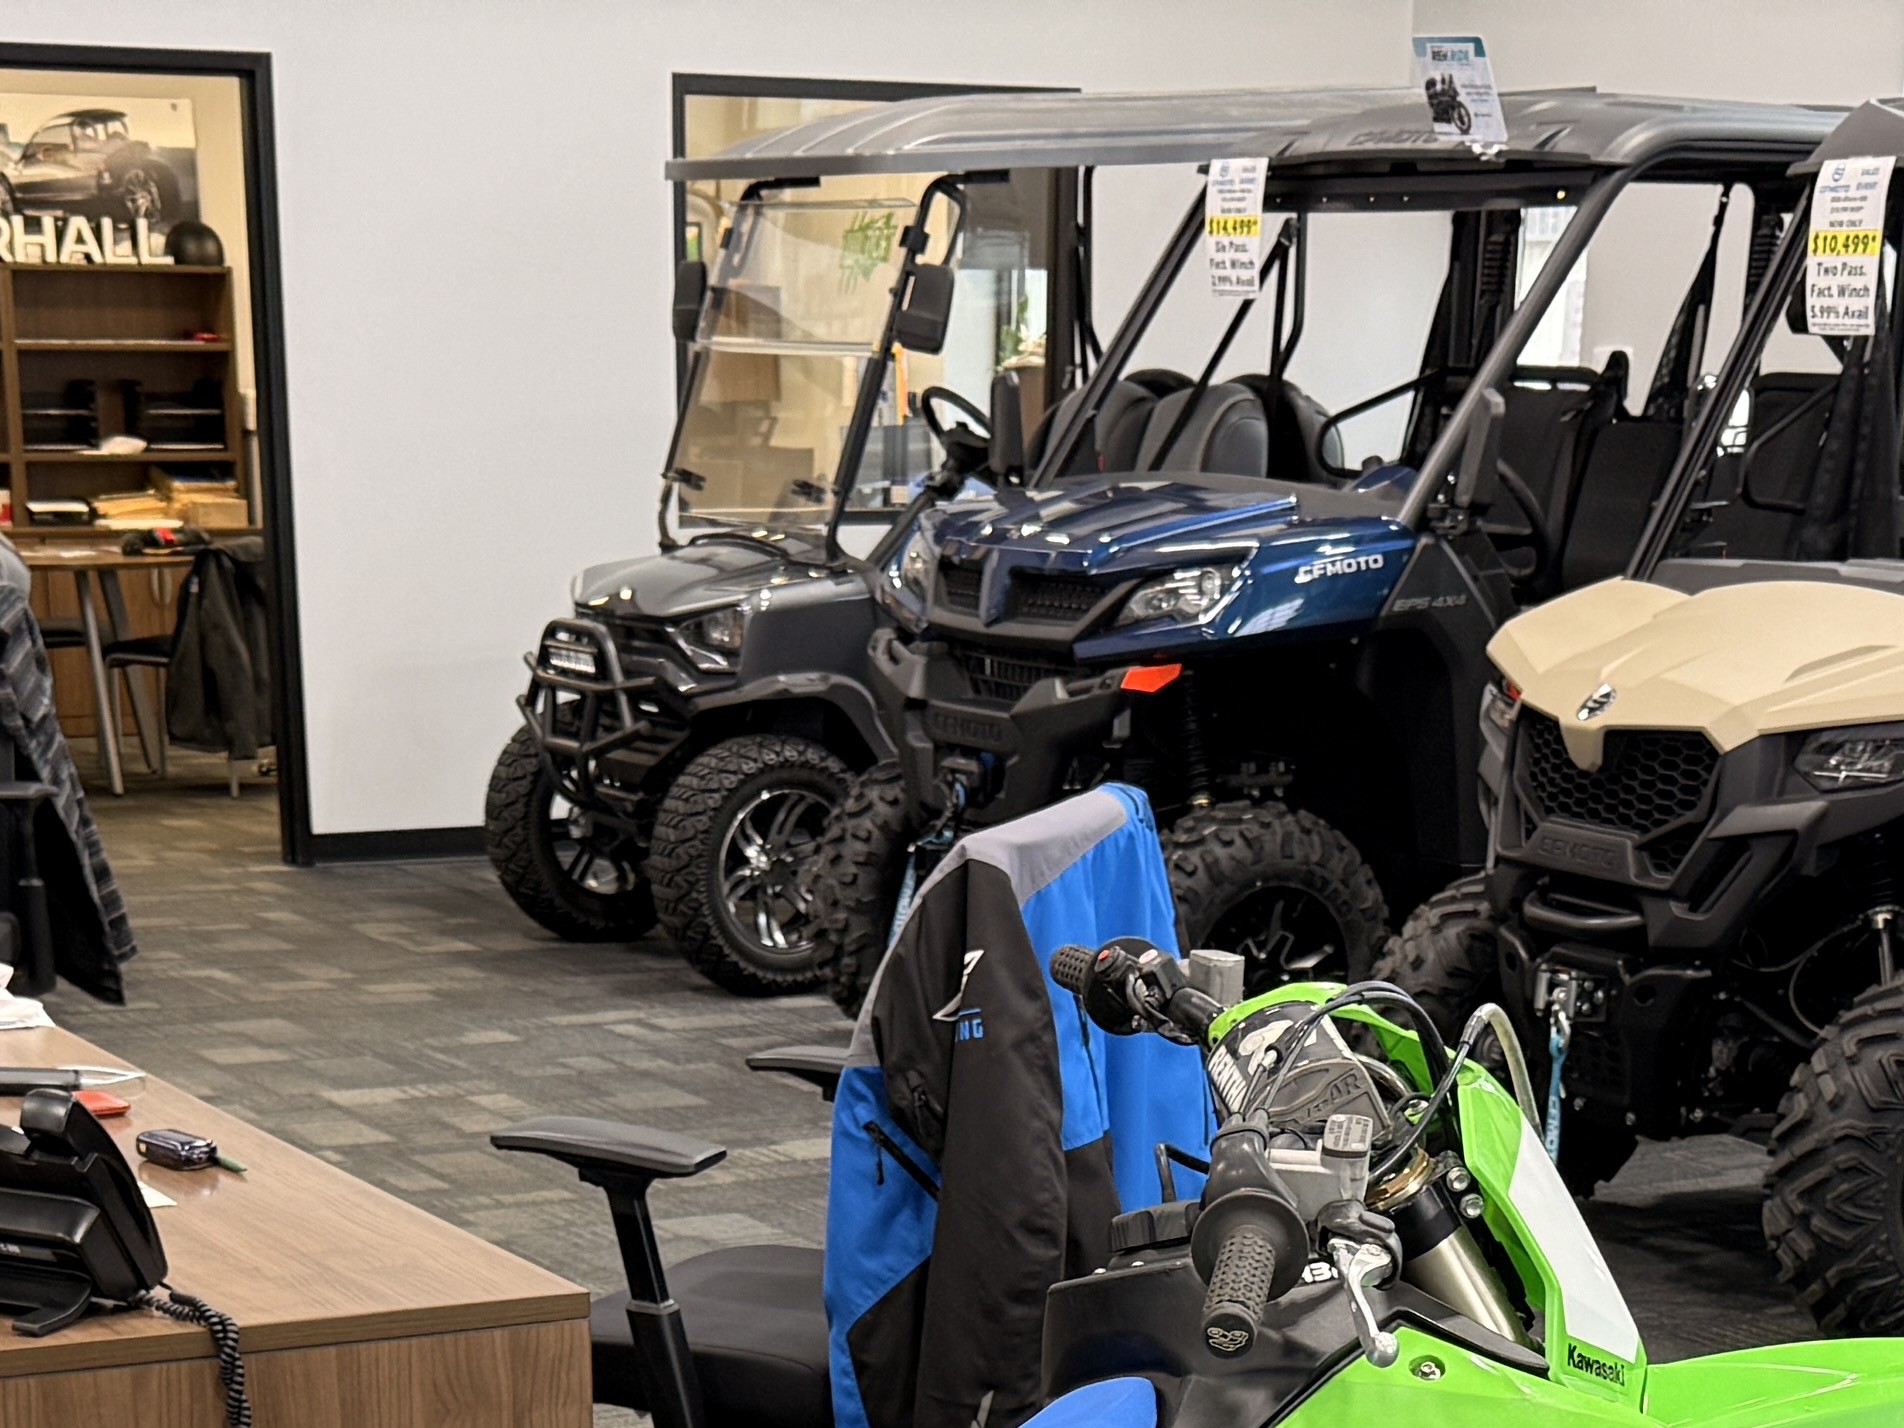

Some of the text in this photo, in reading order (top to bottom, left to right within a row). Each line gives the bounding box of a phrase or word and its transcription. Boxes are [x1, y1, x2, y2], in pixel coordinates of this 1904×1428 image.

[1816, 261, 1838, 277] Two
[1837, 283, 1870, 299] Winch
[1842, 304, 1870, 320] Avail
[1295, 553, 1386, 584] CFMOTO
[1567, 1342, 1626, 1388] Kawasaki
